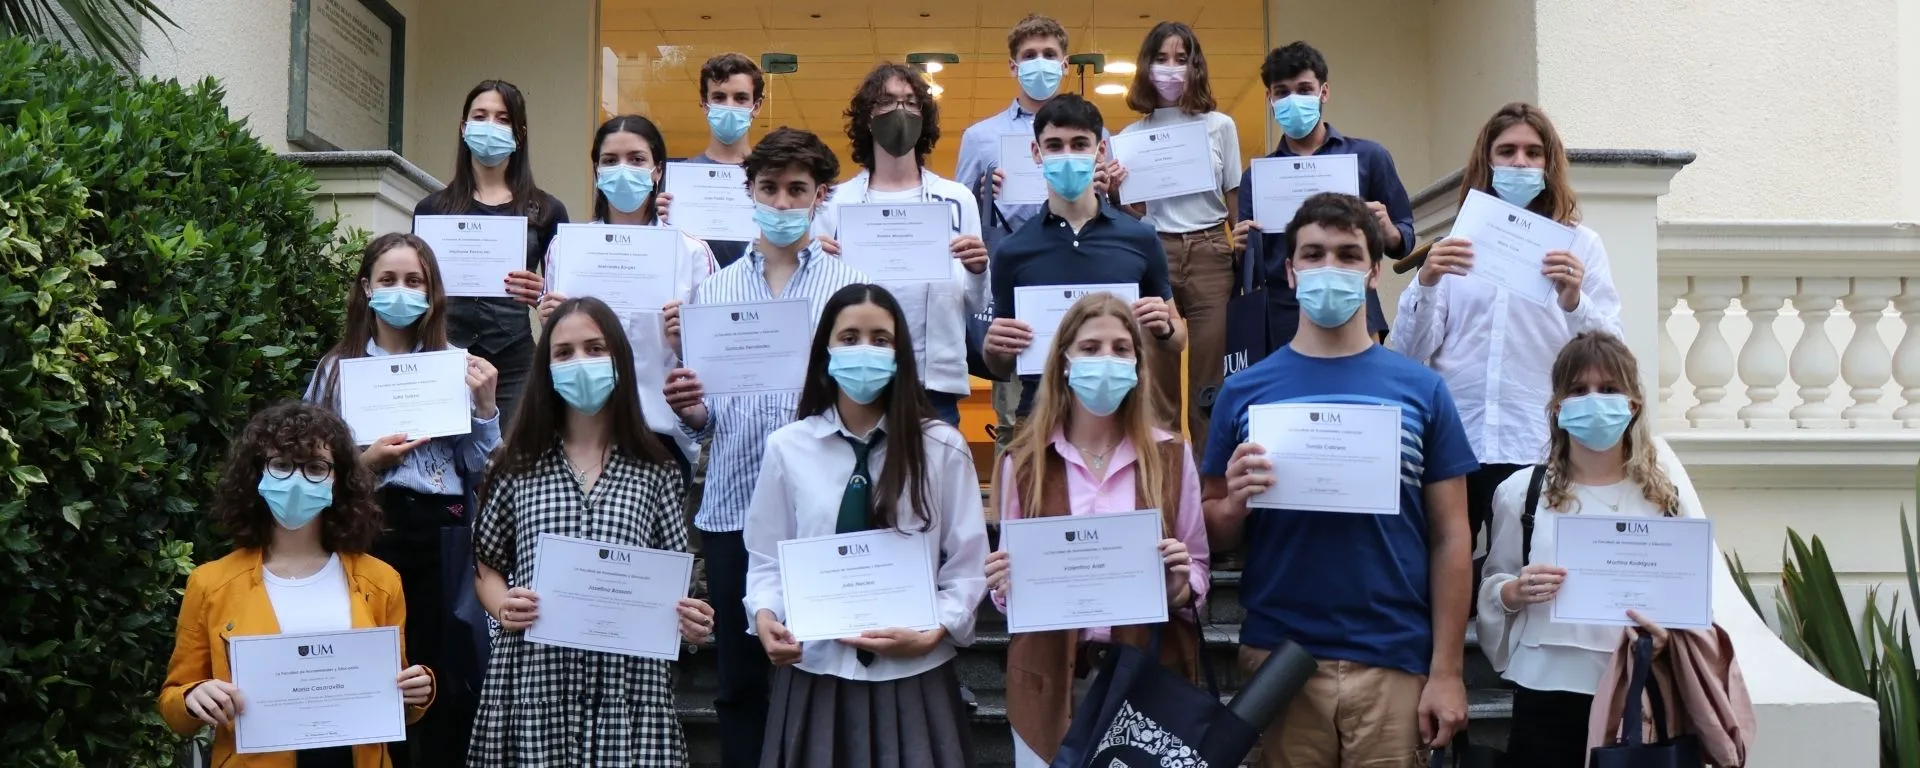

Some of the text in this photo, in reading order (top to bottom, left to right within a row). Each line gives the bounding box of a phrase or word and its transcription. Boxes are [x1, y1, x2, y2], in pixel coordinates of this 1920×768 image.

[1157, 132, 1170, 140] UM
[466, 222, 482, 230] UM
[1515, 216, 1532, 230] UM
[614, 234, 631, 243] UM
[741, 312, 759, 321] UM
[1228, 348, 1248, 374] UM
[400, 364, 418, 372] UM
[1321, 412, 1341, 423] UM
[1628, 522, 1649, 534] UM
[1077, 530, 1098, 541] UM
[849, 544, 870, 555] UM
[610, 550, 631, 563] UM
[311, 644, 334, 655] UM
